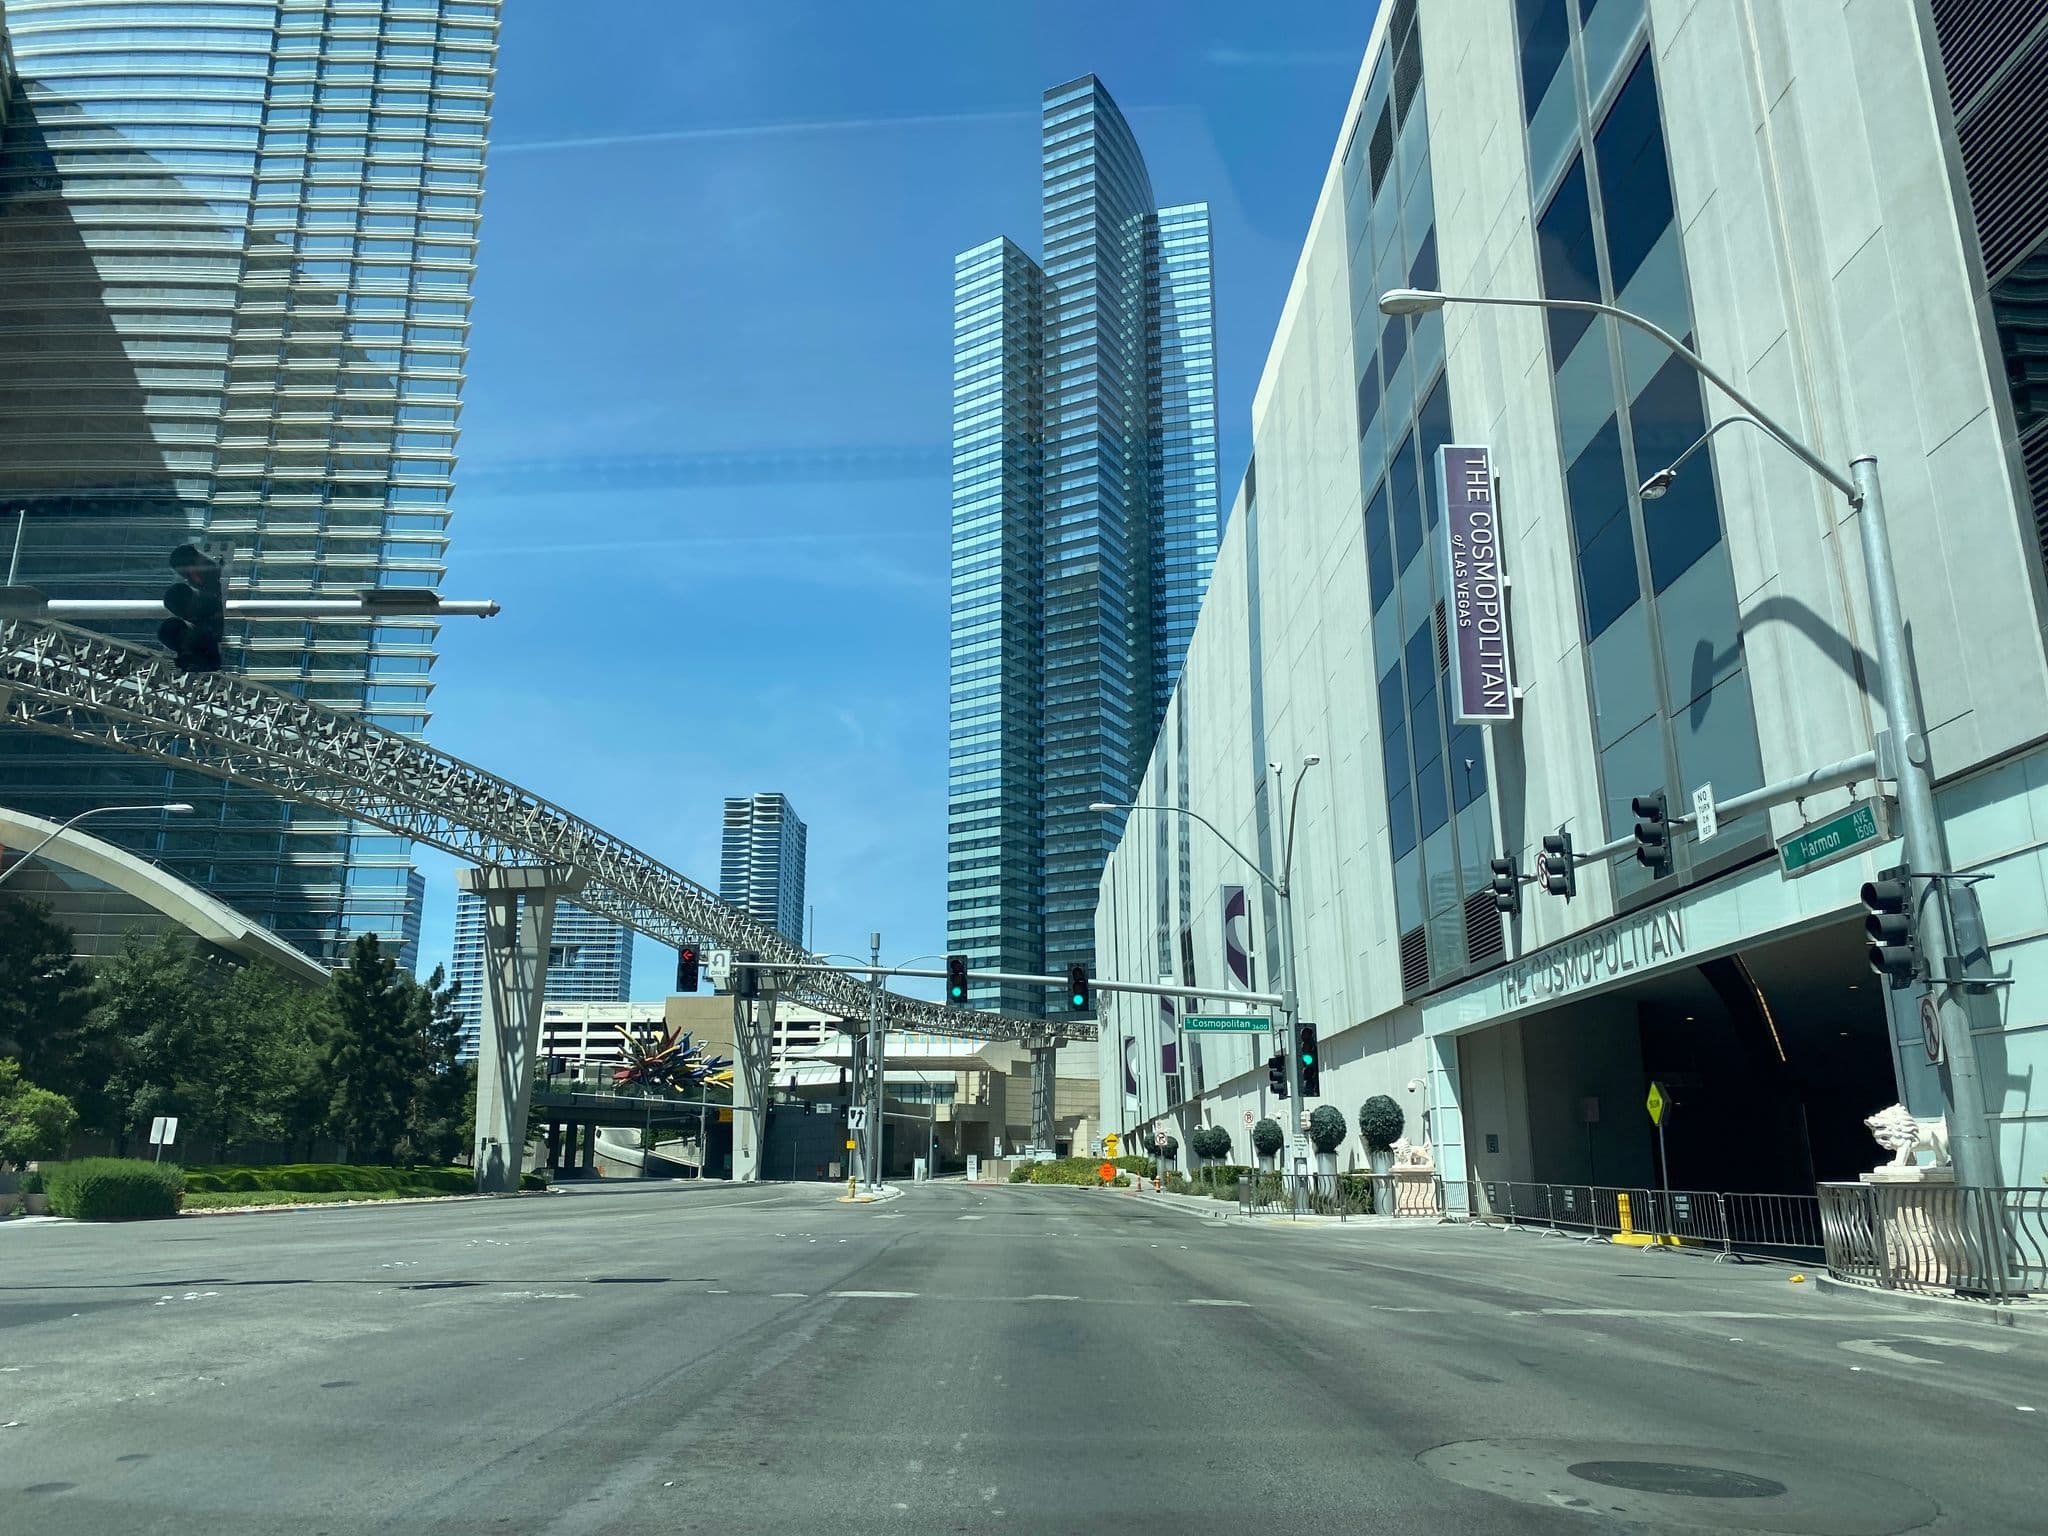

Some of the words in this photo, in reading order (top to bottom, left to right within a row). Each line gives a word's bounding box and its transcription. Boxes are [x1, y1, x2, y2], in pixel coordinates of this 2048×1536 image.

[1464, 454, 1490, 503] THE
[1452, 534, 1466, 549] of
[1454, 551, 1468, 578] LAS
[1456, 582, 1472, 627] VEGAS
[1469, 511, 1507, 708] COSMOPOLITAN
[1697, 790, 1707, 802] NO
[1698, 803, 1710, 814] TURN
[1852, 810, 1868, 827] AVE
[1702, 825, 1712, 835] RED
[1855, 822, 1875, 840] 1500
[1800, 831, 1841, 858] Harmon
[1498, 962, 1528, 1010] THE
[1530, 901, 1687, 996] COSMOPOLITAN
[1192, 1018, 1251, 1030] Cosmopolitan
